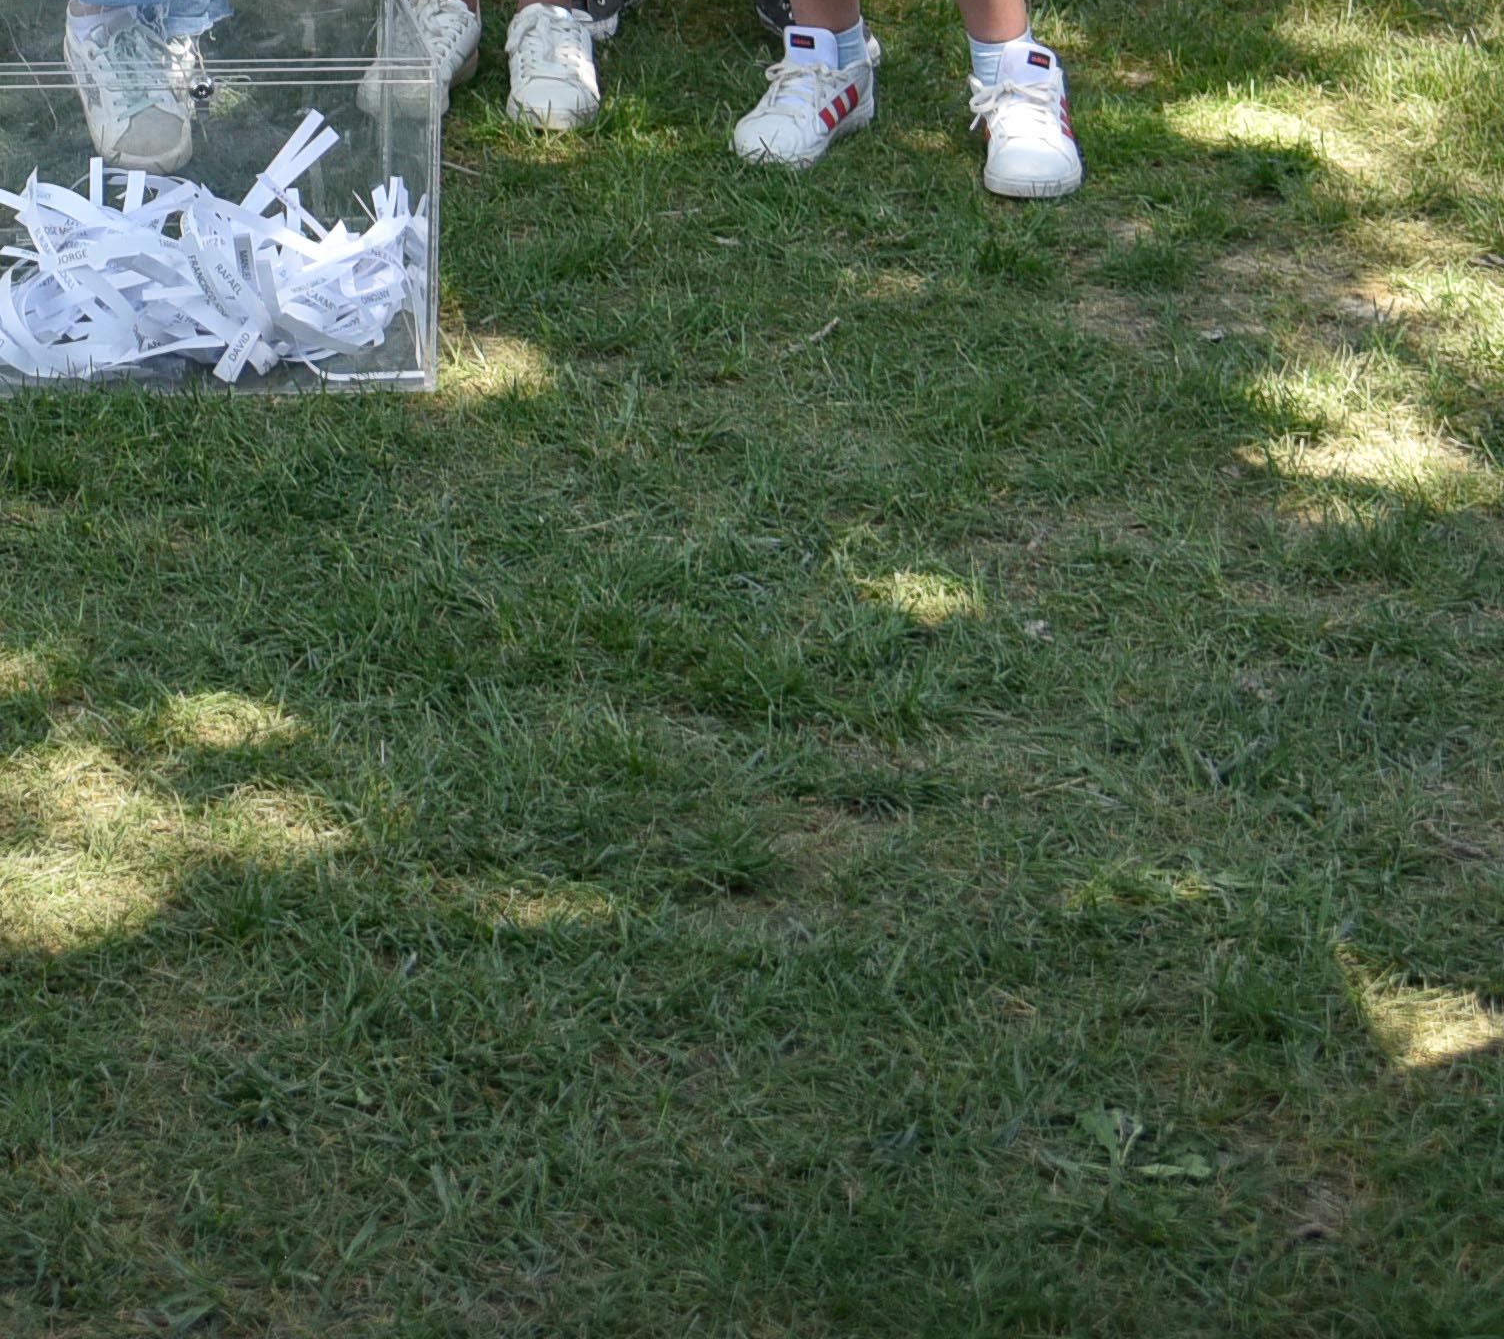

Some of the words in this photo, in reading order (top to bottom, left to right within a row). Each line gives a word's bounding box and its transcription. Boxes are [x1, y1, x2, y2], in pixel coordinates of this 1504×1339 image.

[57, 249, 88, 266] JORGE
[214, 263, 242, 296] RAFAEL
[228, 332, 250, 362] DAVID
